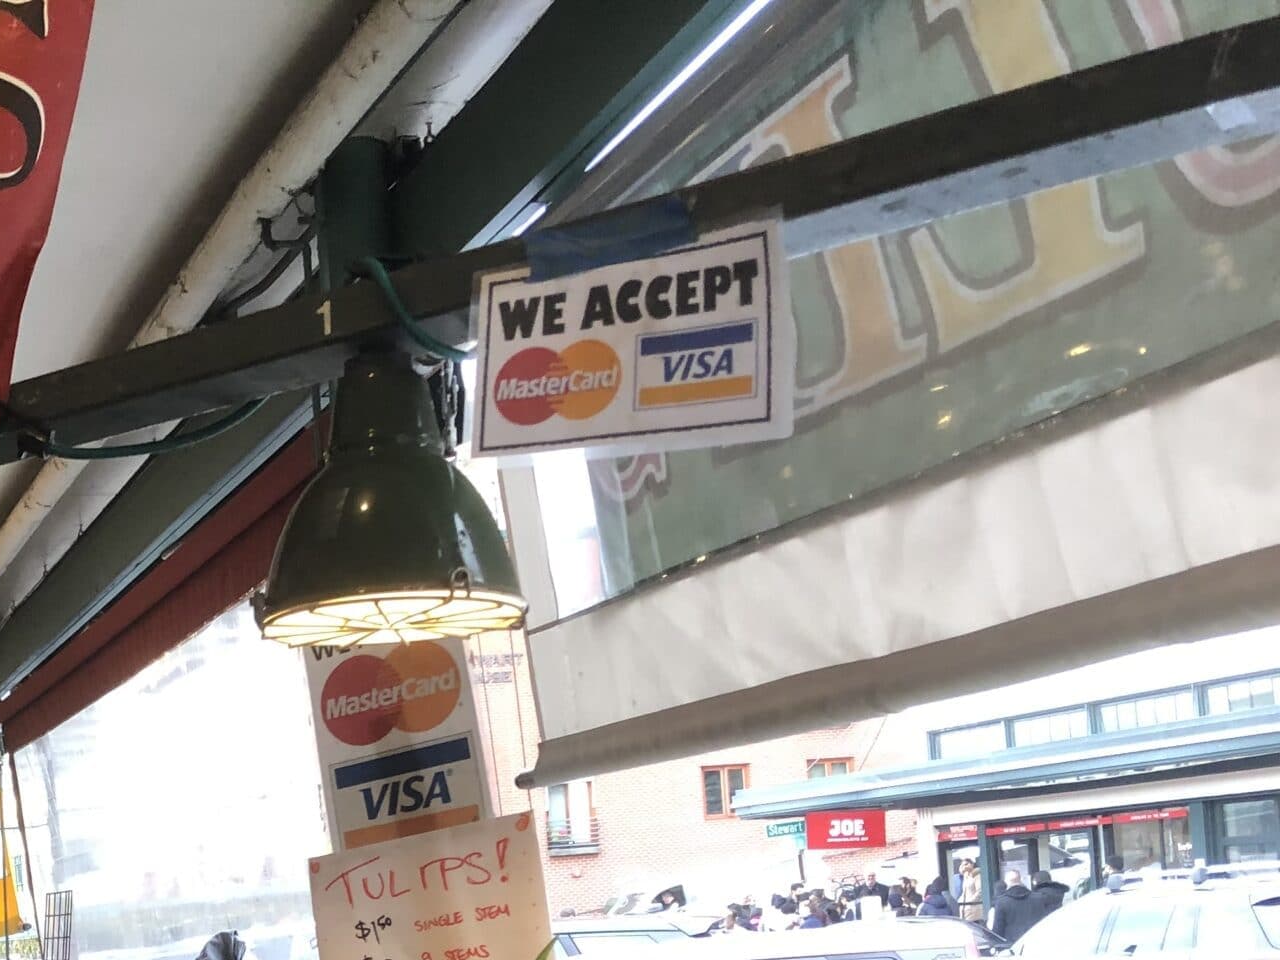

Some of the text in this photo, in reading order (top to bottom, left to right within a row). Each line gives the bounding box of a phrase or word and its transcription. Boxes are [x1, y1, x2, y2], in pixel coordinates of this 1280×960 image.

[315, 298, 332, 336] 1
[497, 257, 760, 341] WE ACCEPT
[662, 347, 734, 383] VISA
[495, 367, 619, 402] MasterCard
[325, 667, 457, 721] MasterCard
[359, 770, 452, 821] VISA
[768, 821, 803, 837] Stewart
[828, 819, 866, 837] JOE
[324, 837, 510, 910] TULIPS!
[413, 911, 464, 933] SINGLE
[475, 903, 511, 922] STEM
